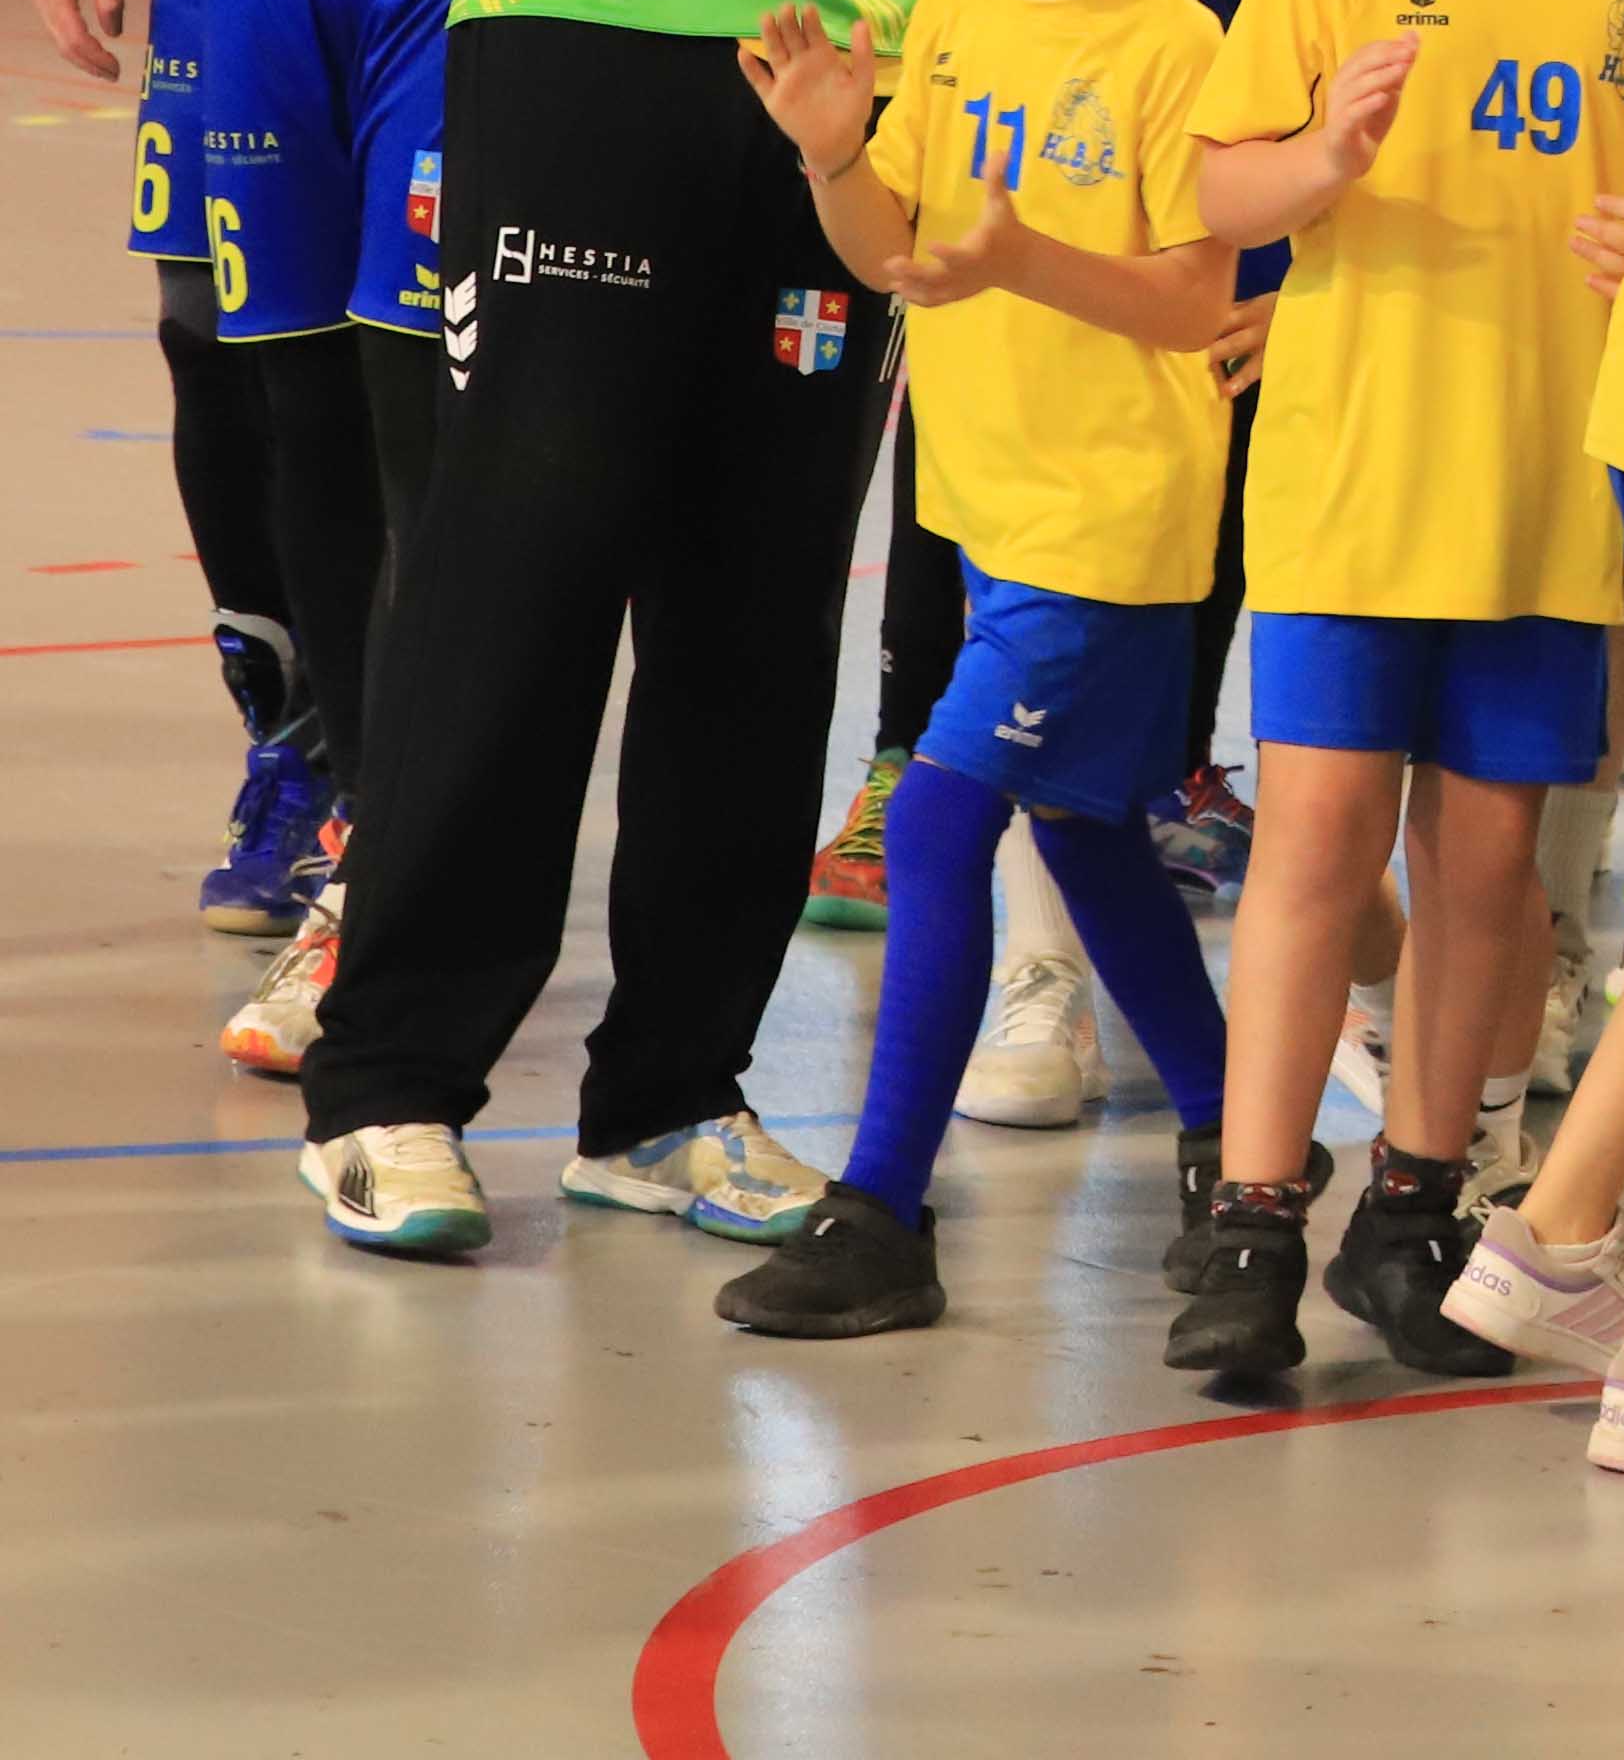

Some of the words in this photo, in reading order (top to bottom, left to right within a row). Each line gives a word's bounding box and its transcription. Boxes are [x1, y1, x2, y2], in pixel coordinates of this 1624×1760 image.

[1396, 12, 1449, 28] erima
[152, 57, 199, 79] HES
[1469, 58, 1582, 155] 49
[963, 91, 1026, 192] 11
[132, 121, 172, 233] 6
[206, 196, 248, 313] 6
[538, 243, 653, 276] HESTIA
[538, 264, 590, 281] SERVICES
